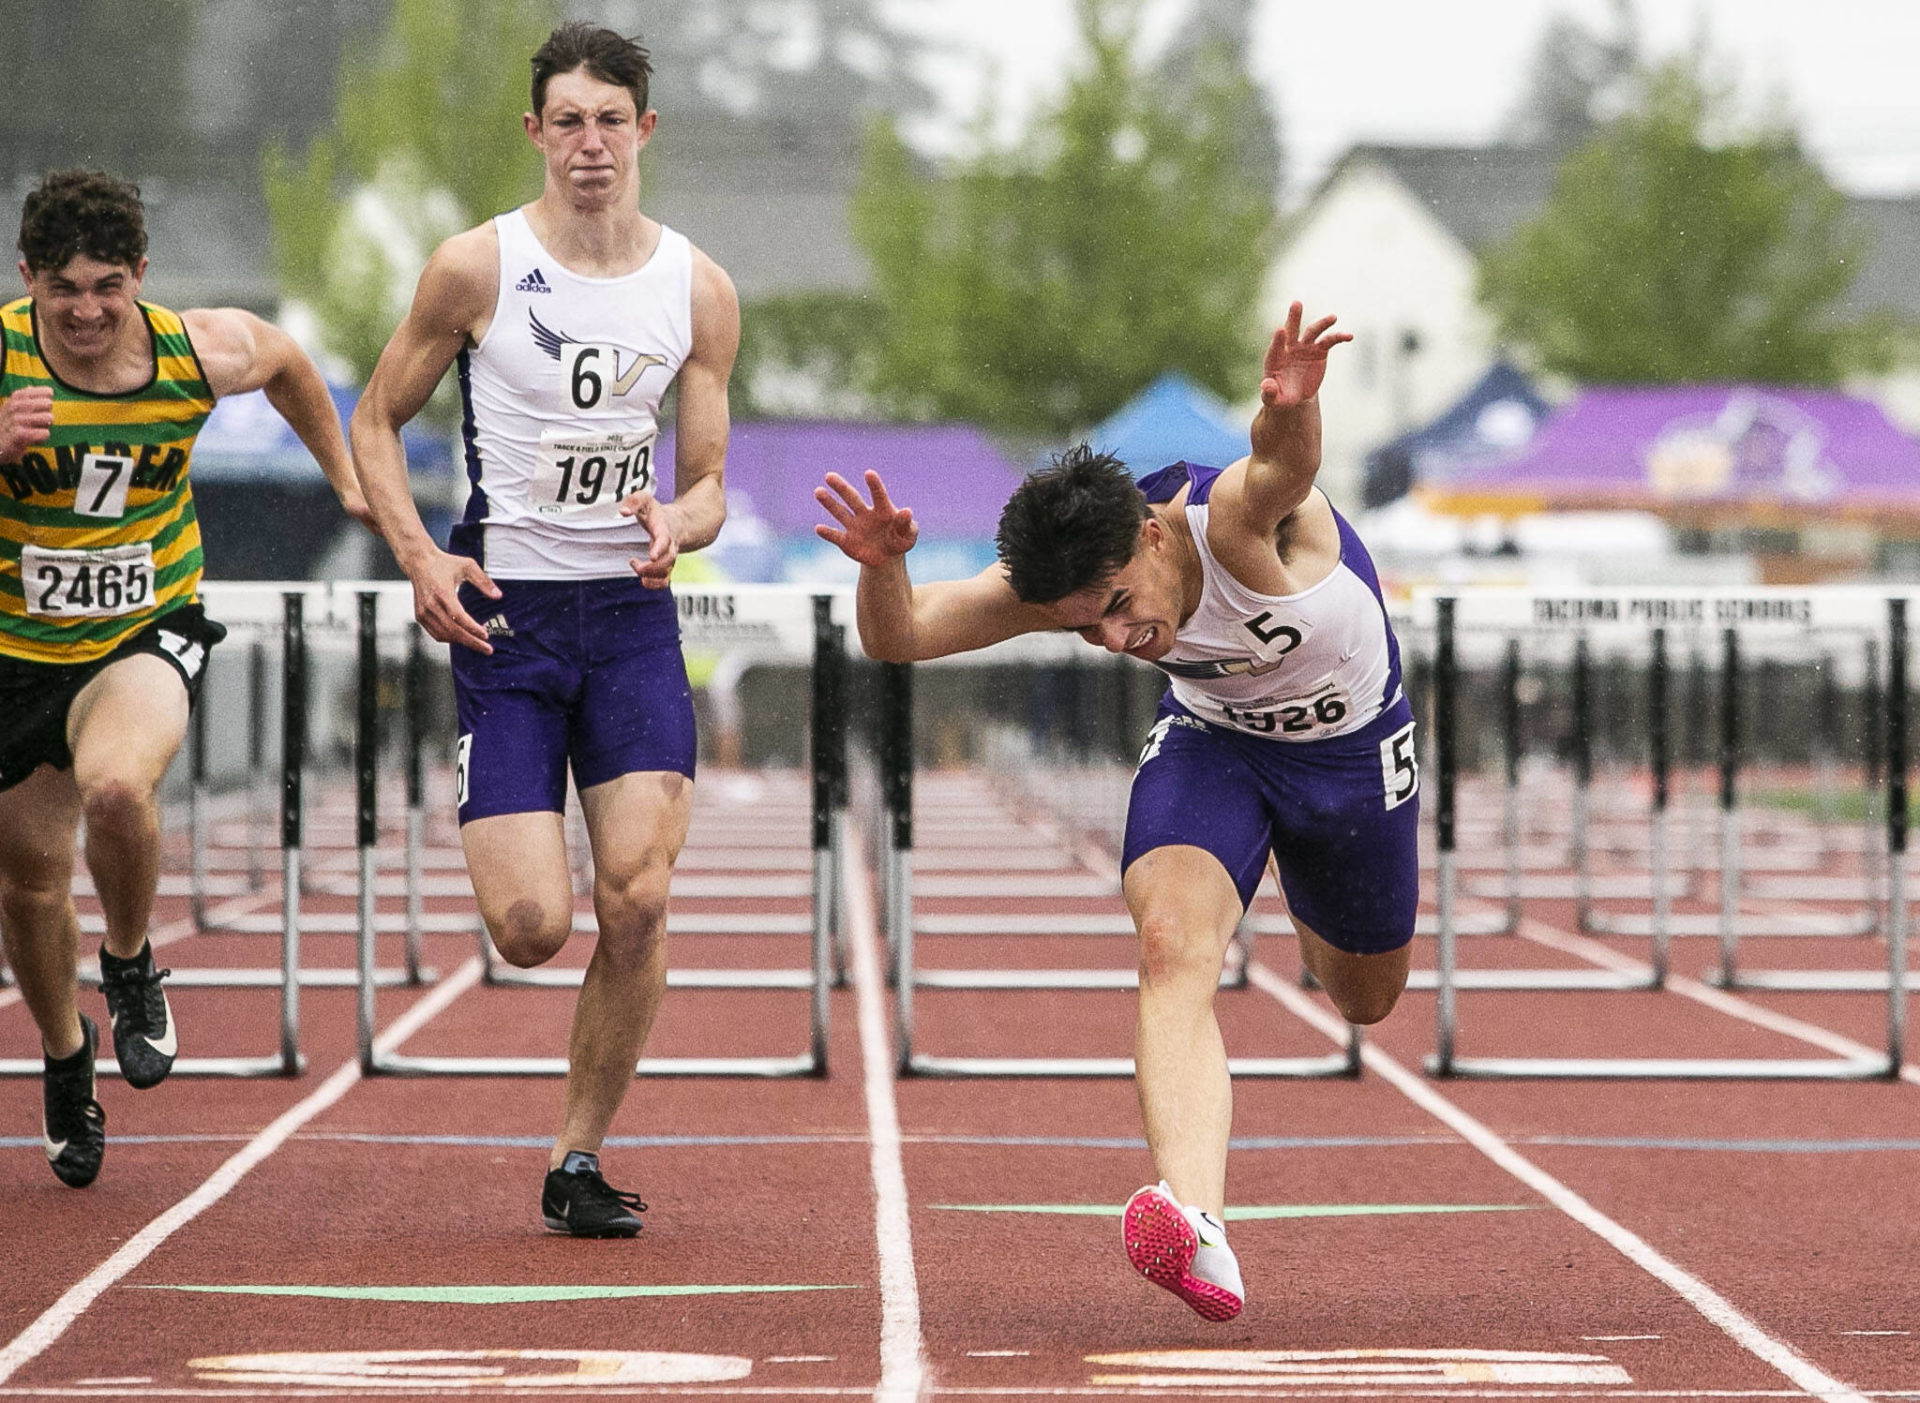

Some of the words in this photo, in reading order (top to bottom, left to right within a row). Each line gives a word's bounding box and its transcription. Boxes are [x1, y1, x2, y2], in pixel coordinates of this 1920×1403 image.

[571, 348, 602, 409] 6
[89, 460, 123, 512] 7
[37, 564, 147, 610] 2465
[1630, 598, 1702, 620] PUBLIC
[1244, 611, 1302, 655] 5
[1392, 732, 1416, 802] 5
